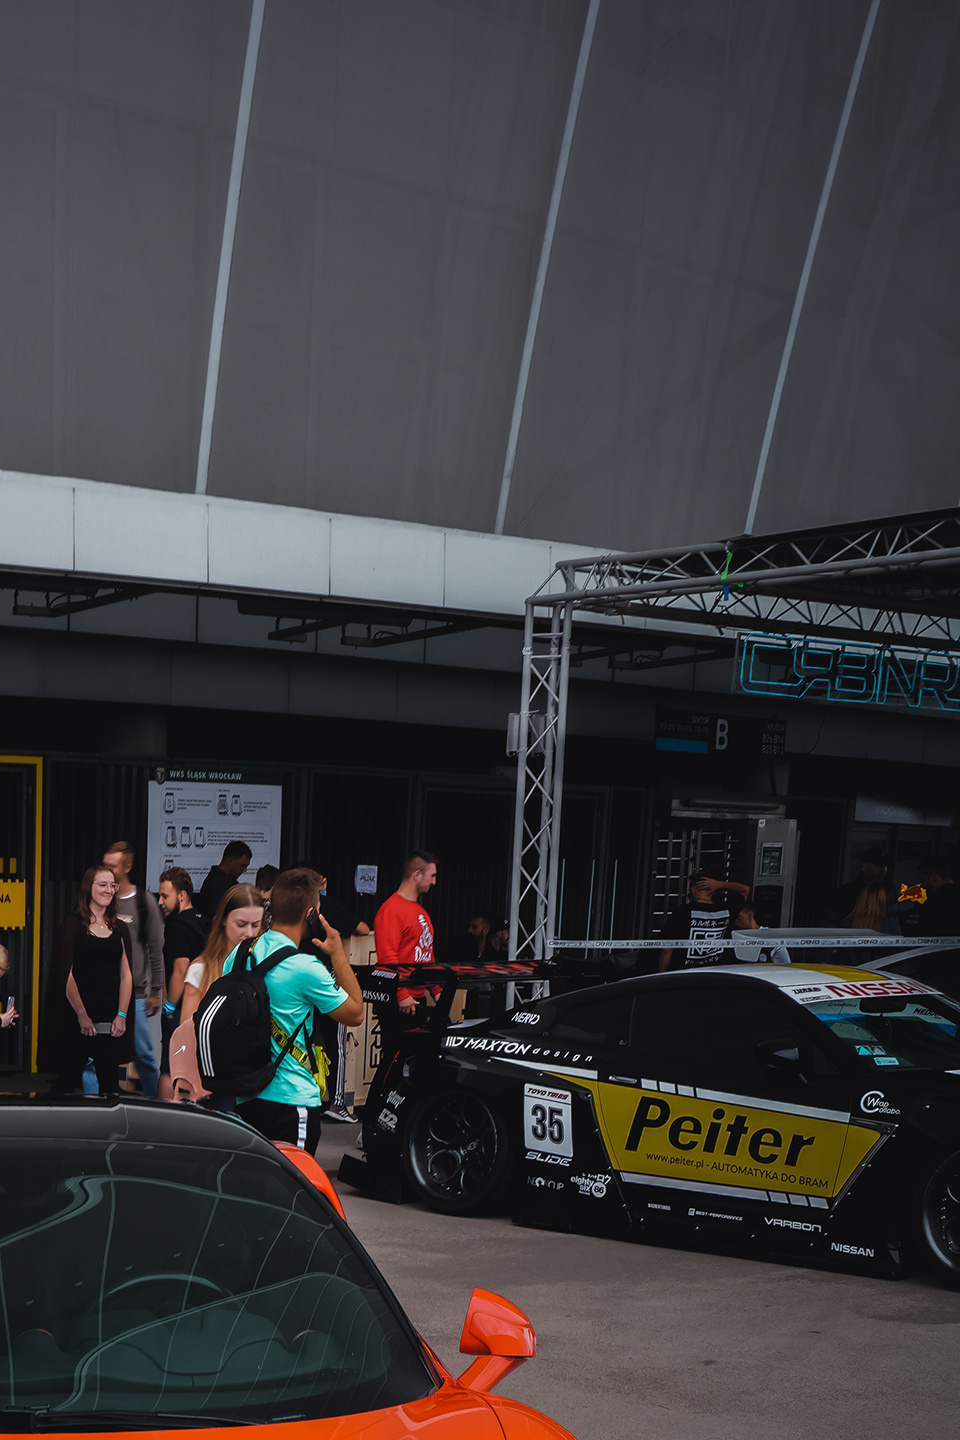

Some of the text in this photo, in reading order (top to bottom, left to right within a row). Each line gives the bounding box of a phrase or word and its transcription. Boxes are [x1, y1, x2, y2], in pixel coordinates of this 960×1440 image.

[715, 718, 729, 751] B
[169, 769, 242, 781] WKS ŚLĄSK WROCŁAW
[464, 1037, 532, 1056] MAXTON
[532, 1046, 594, 1063] design
[527, 1087, 569, 1101] TOYO TIRES
[531, 1103, 564, 1145] 35
[624, 1095, 816, 1167] Peiter
[524, 1150, 573, 1168] SLIDE
[645, 1151, 705, 1169] www.peiter.pl
[711, 1160, 780, 1182] AUTOMATYKA
[780, 1172, 797, 1184] DO
[798, 1176, 829, 1189] BRAM
[763, 1216, 822, 1233] VARBON
[830, 1241, 875, 1258] NISSAN
